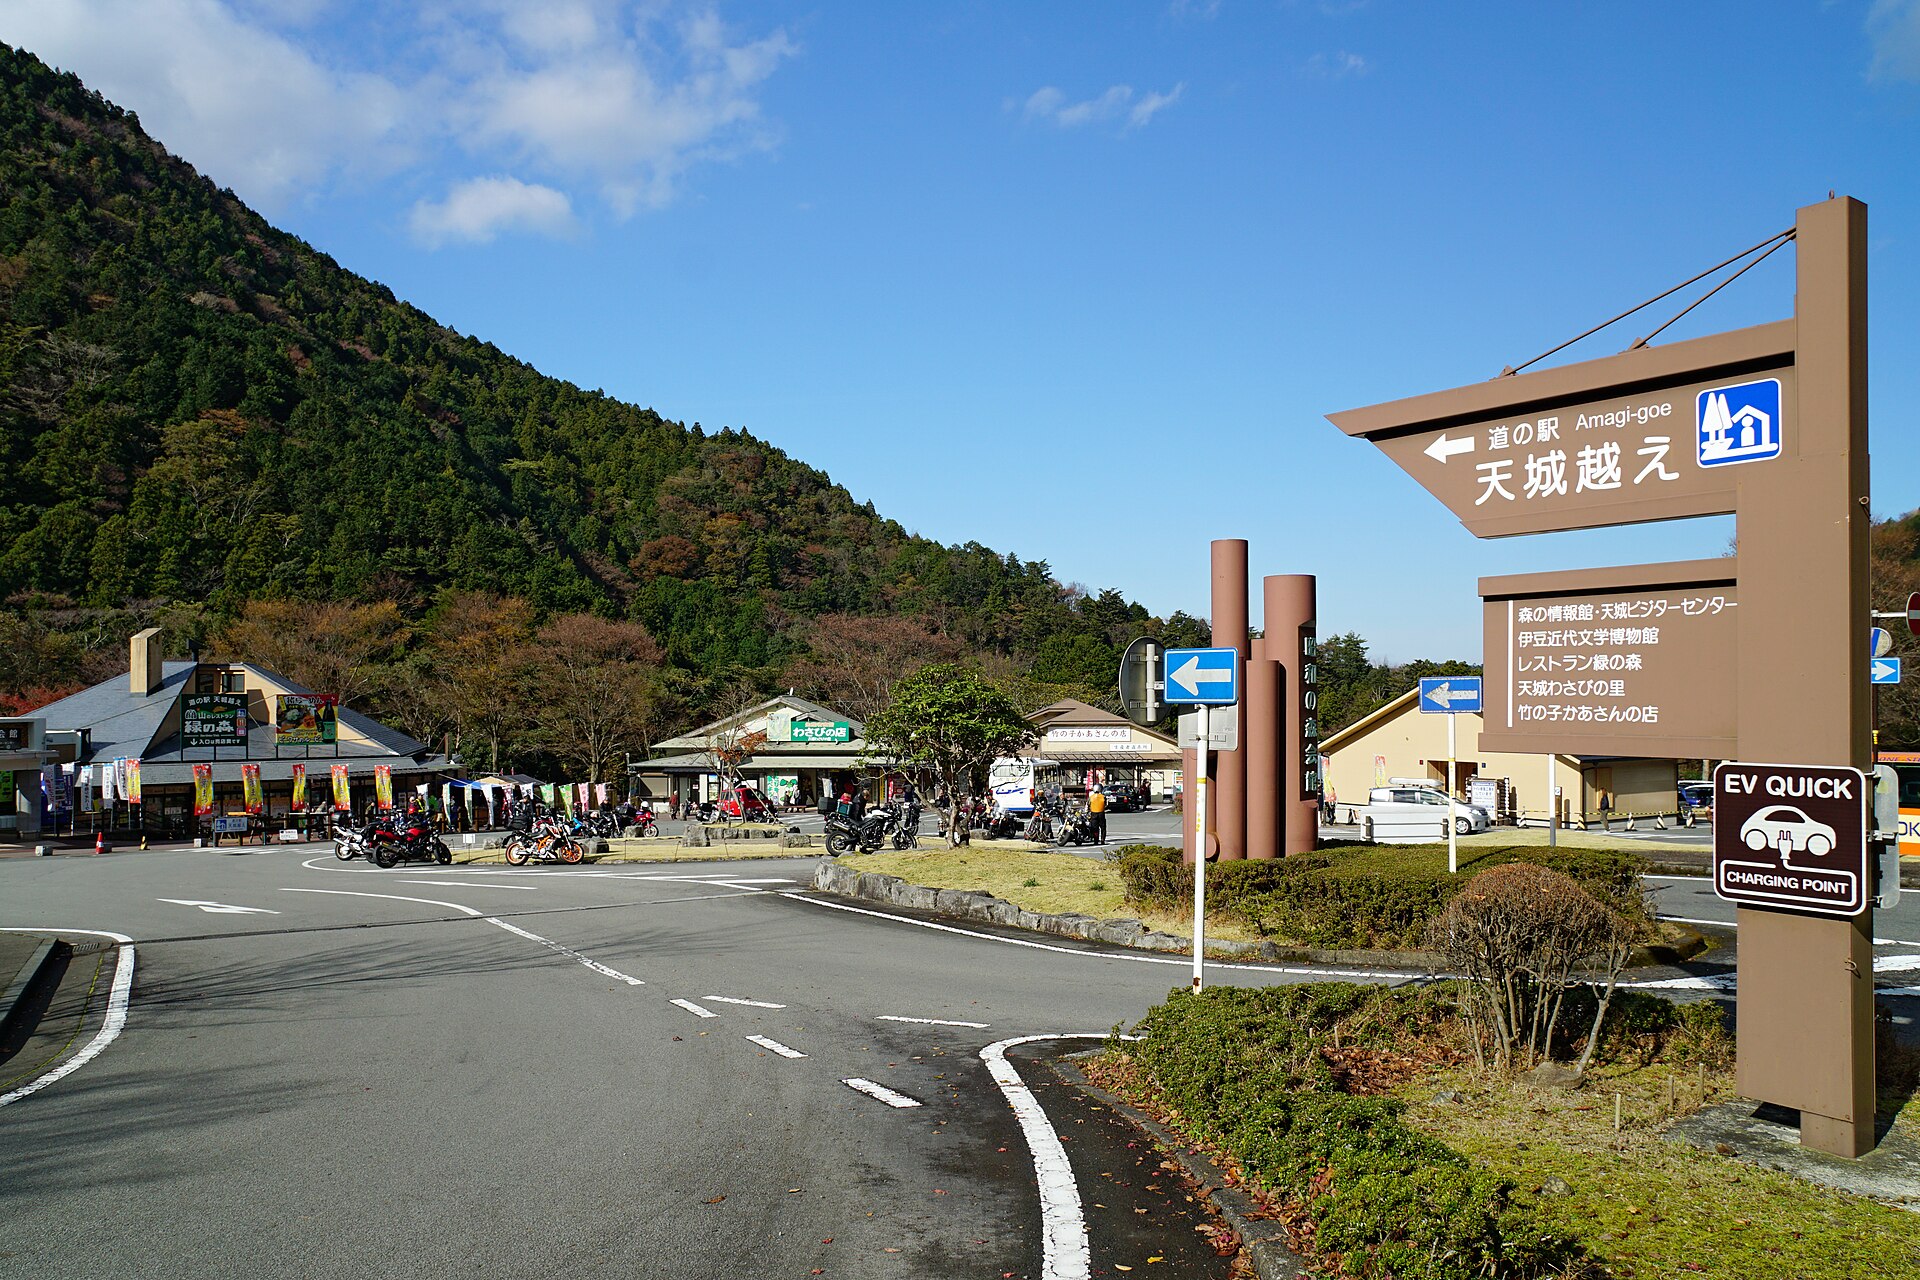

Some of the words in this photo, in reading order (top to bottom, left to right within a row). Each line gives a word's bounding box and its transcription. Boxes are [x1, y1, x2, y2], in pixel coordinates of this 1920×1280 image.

[1575, 402, 1672, 431] Amagi-goe
[1488, 416, 1561, 451] 道の駅
[1475, 436, 1680, 506] 天城越え
[1517, 596, 1738, 623] 森の情報館・天城ビジターセンター
[1517, 626, 1659, 648] 伊豆近代文学博物館
[1517, 654, 1643, 672] レストラン緑の森
[1517, 679, 1626, 697] 天城わさびの里
[198, 711, 234, 719] 山のレストラン
[1304, 636, 1317, 792] 昭和の森会館
[1517, 704, 1659, 723] 竹の子かあさんの店
[184, 720, 235, 733] 緑の森
[792, 727, 847, 738] わさびの店
[1051, 729, 1128, 739] 竹の子かあさんの店
[1725, 774, 1758, 794] EV
[1765, 775, 1853, 799] QUICK
[1726, 871, 1799, 889] CHARGING
[1802, 879, 1849, 894] POINT
